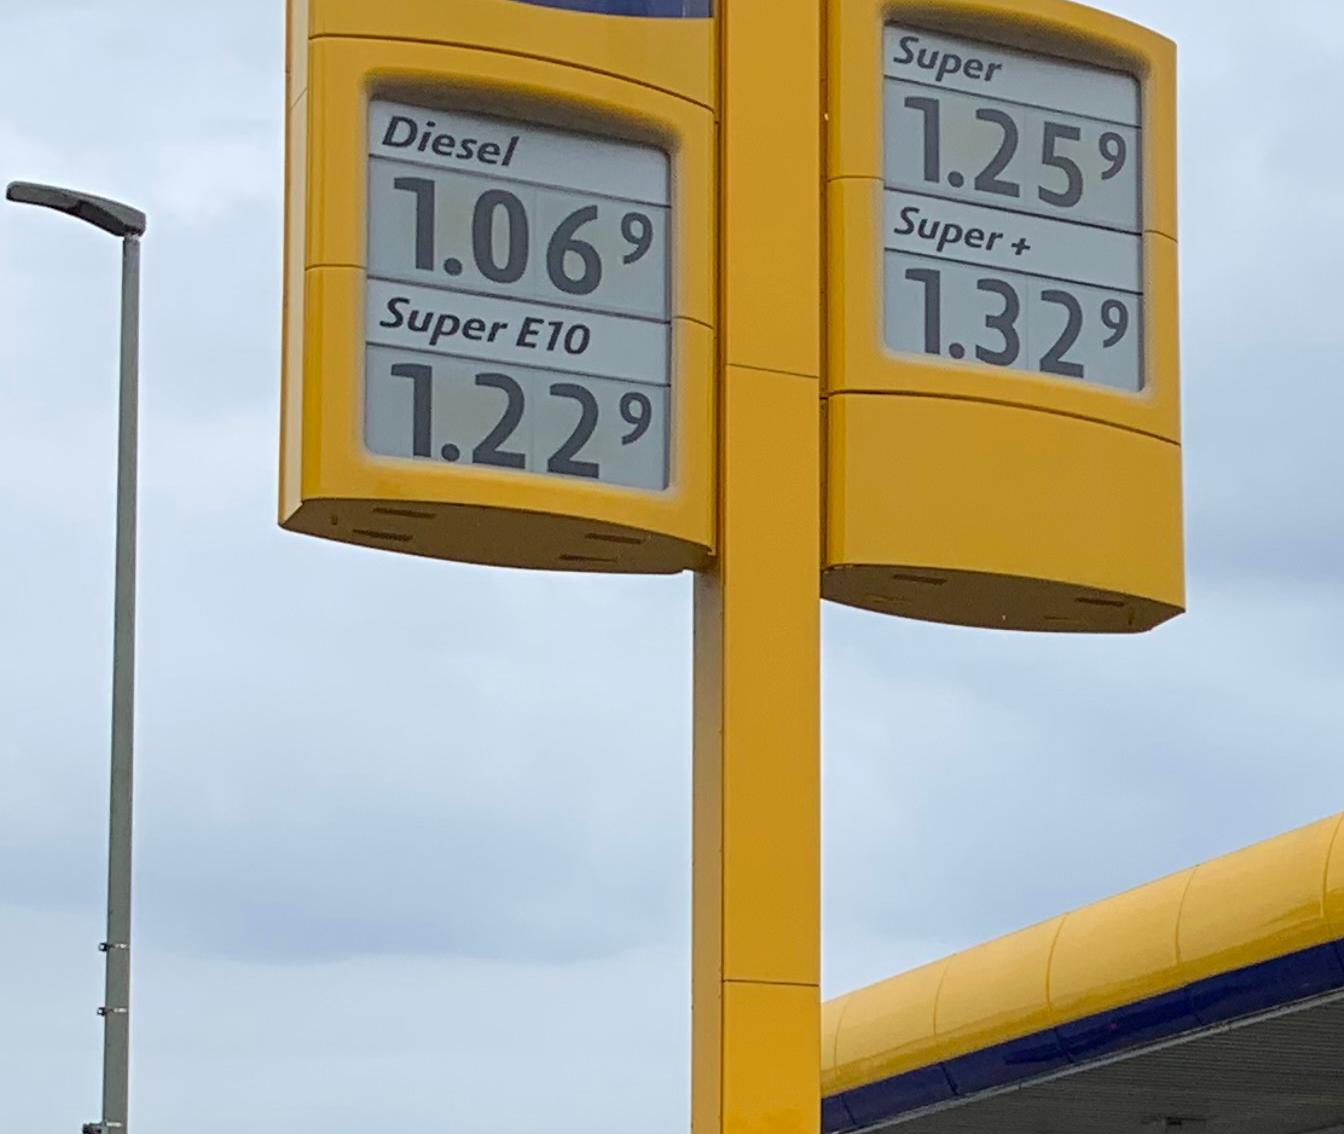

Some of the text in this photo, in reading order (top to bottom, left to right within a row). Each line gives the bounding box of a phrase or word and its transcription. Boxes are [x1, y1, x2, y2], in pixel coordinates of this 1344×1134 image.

[893, 36, 1003, 82] Super
[382, 115, 520, 166] Diesel
[894, 206, 1004, 252] Super
[379, 296, 591, 355] Super E10
